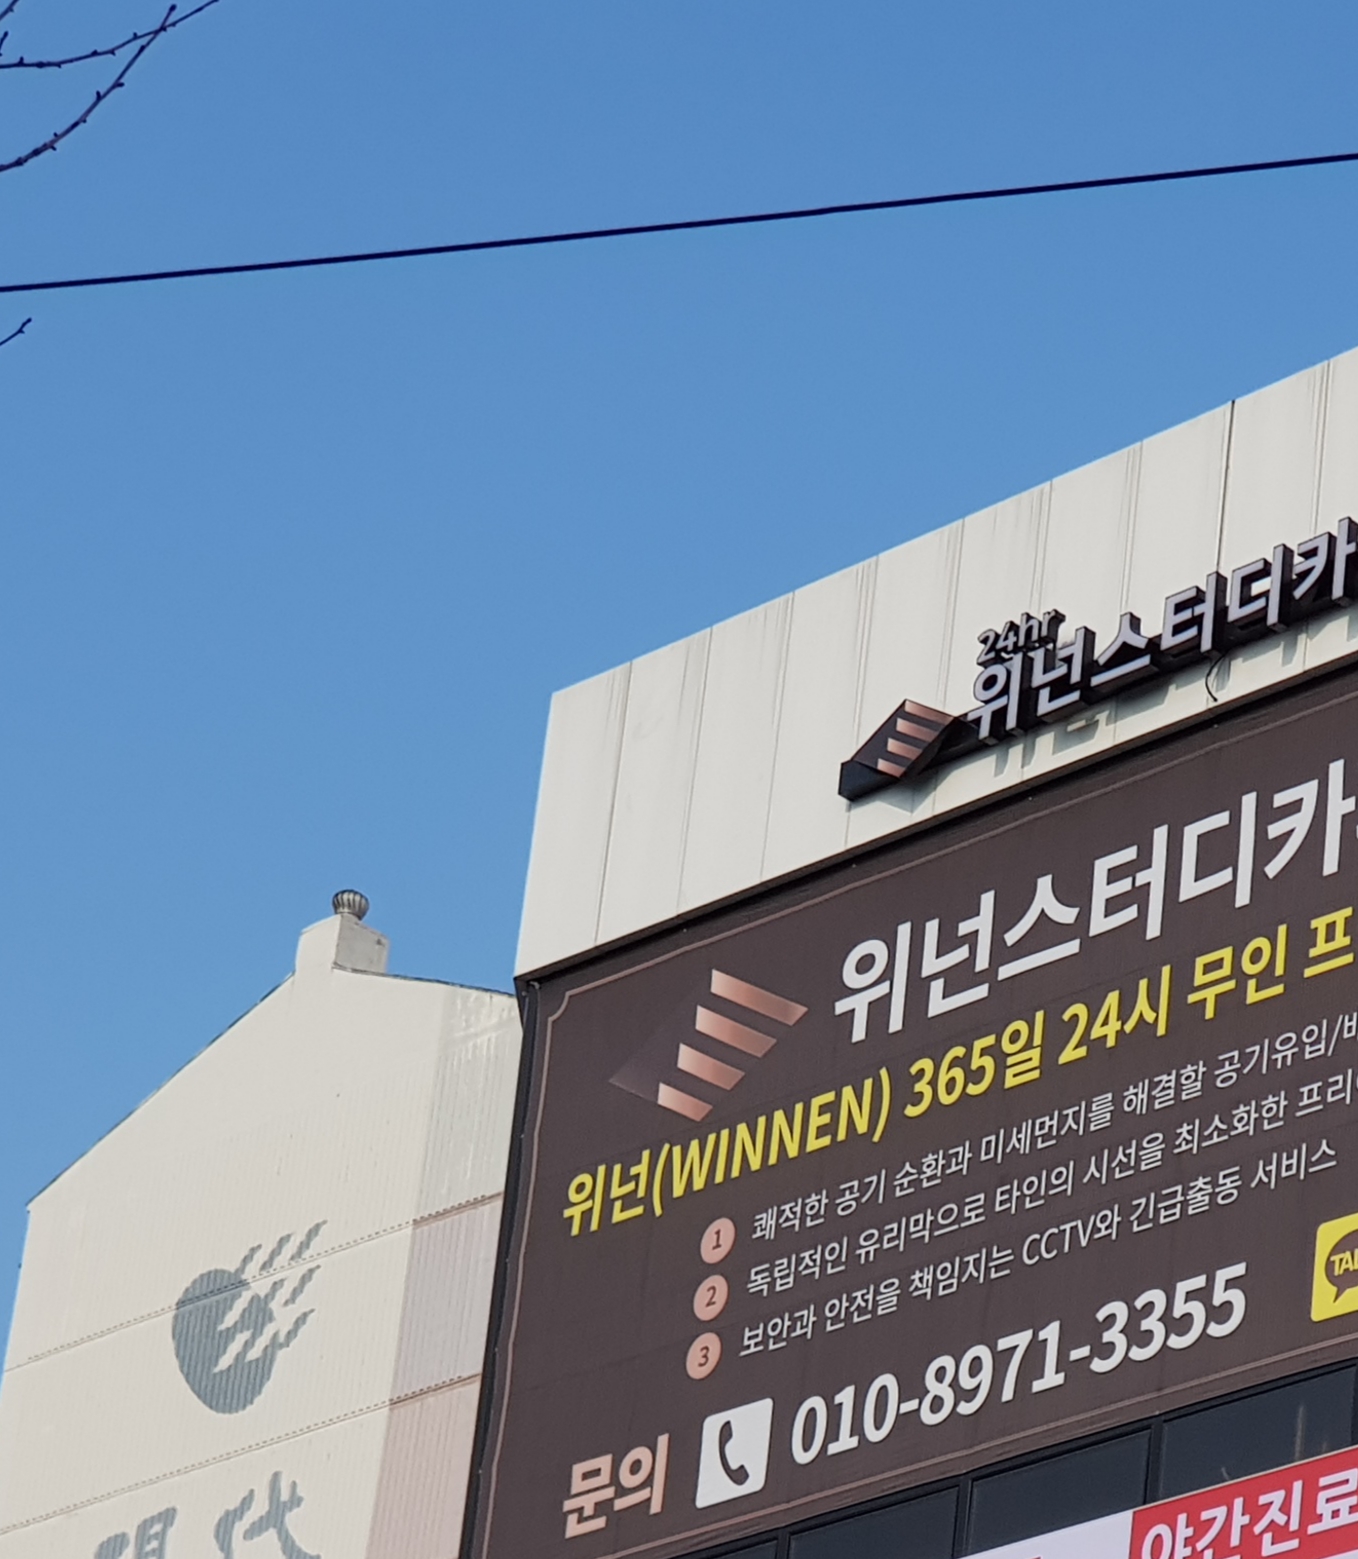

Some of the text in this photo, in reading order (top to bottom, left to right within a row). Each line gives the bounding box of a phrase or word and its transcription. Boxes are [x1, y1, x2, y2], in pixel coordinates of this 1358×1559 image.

[977, 609, 1065, 665] 24hr
[563, 1066, 891, 1237] 위넌(WINNEN)
[904, 1010, 1044, 1117] 365일
[1058, 964, 1173, 1066] 24시
[1186, 924, 1288, 1022] 무인
[752, 1189, 828, 1241] 쾌적한
[835, 1169, 886, 1216] 공기
[893, 1140, 973, 1197] 순환과
[979, 1092, 1114, 1164] 미세먼지를
[1122, 1060, 1206, 1115] 해결할
[739, 1138, 1337, 1356] 보안과 안전을 책임지는 CCTV와 긴급출동 서비스
[747, 1236, 848, 1297] 독립적인
[855, 1193, 985, 1264] 유리막으로
[995, 1160, 1074, 1214] 타인의
[1082, 1131, 1165, 1184] 시선을
[1172, 1091, 1288, 1154] 최소화한
[562, 1262, 1247, 1539] 문의 010-8971-3355
